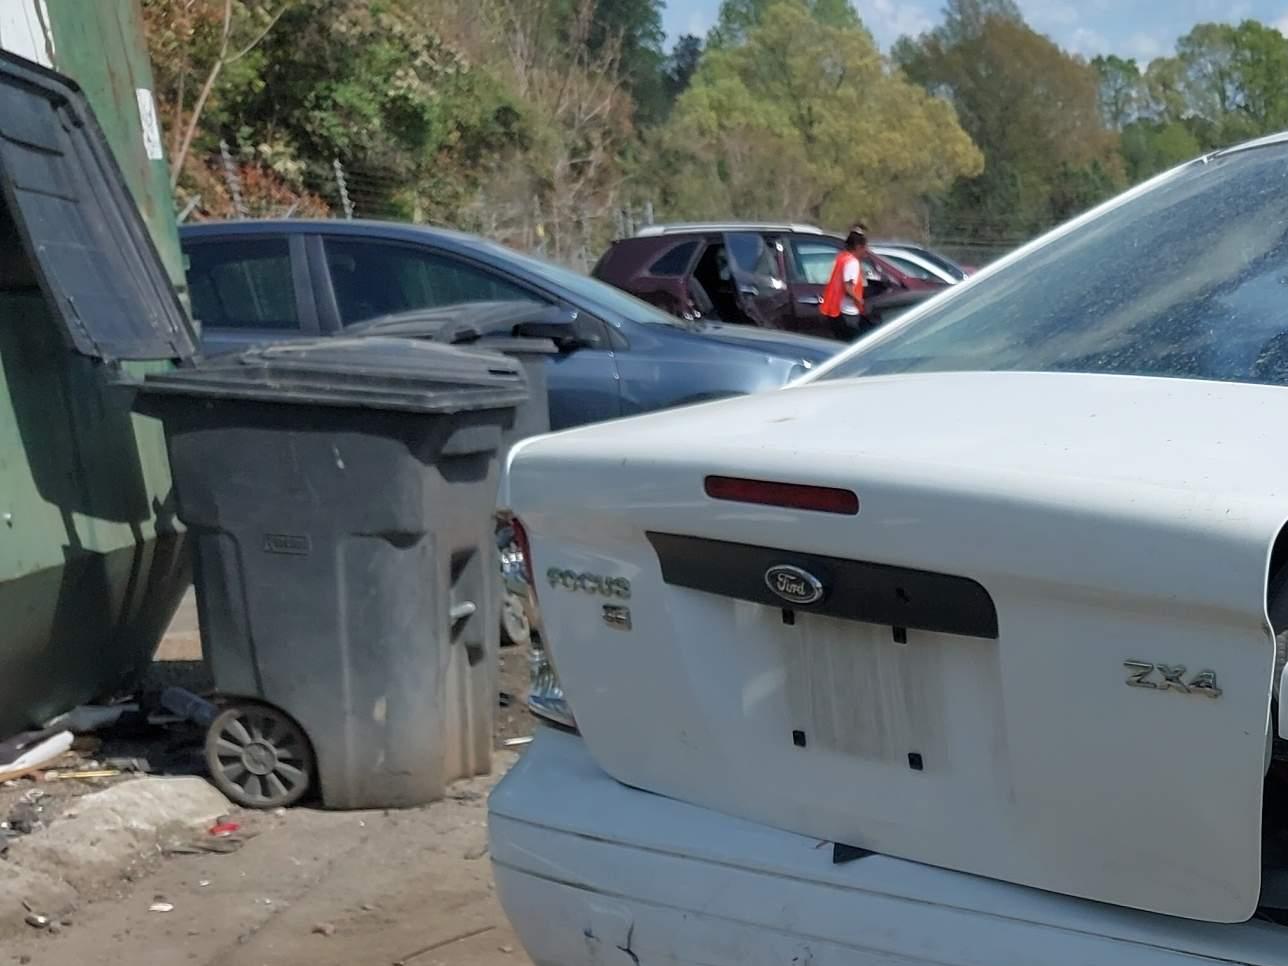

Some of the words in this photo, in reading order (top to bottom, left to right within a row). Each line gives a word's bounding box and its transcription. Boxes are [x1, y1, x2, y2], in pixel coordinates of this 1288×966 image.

[546, 567, 632, 600] FOCUS
[776, 573, 806, 596] Ford
[1123, 659, 1223, 700] ZX4
